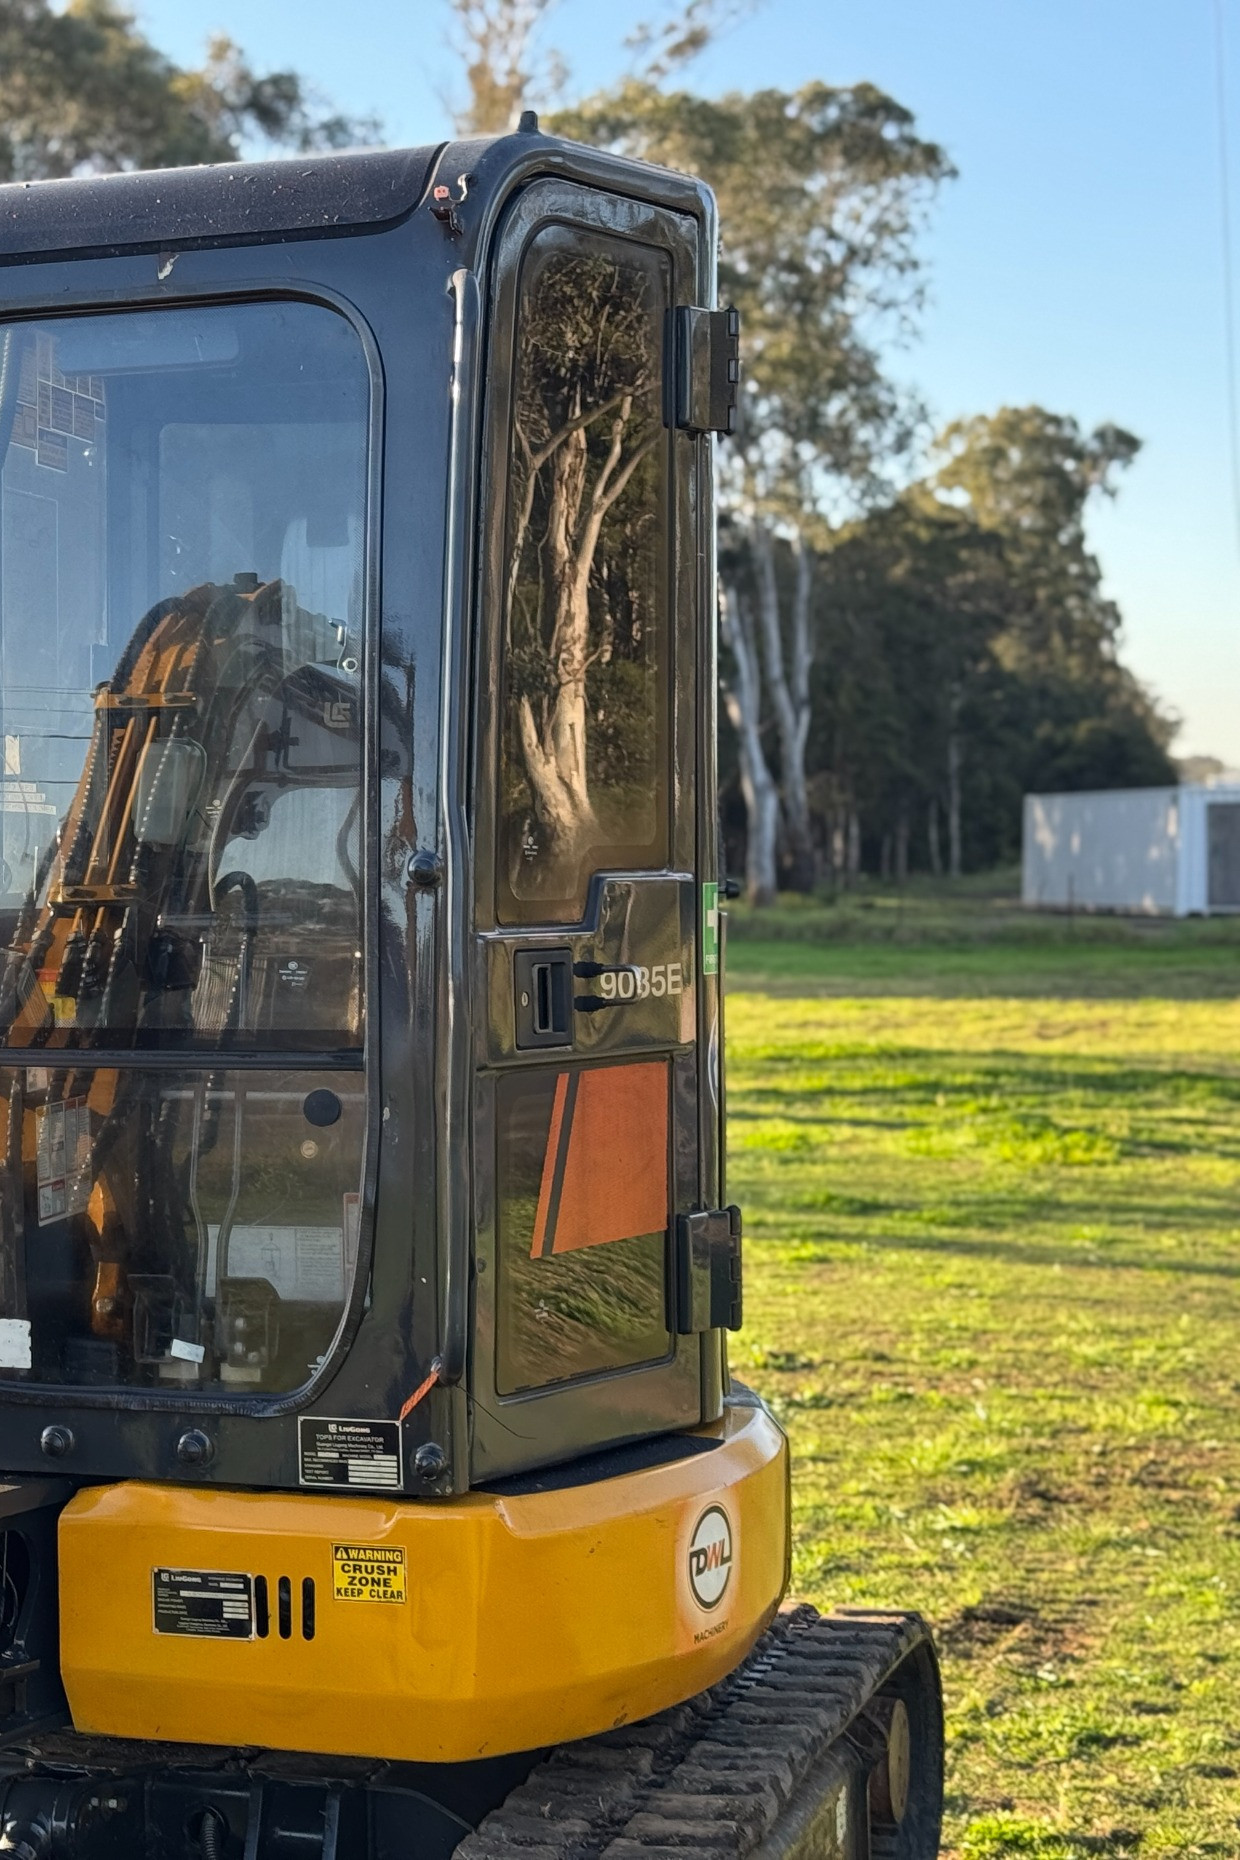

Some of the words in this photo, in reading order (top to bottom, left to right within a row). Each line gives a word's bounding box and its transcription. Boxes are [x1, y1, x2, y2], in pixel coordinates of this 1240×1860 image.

[347, 1435, 384, 1443] EXCAVATOR
[348, 1548, 402, 1562] WARNING
[690, 1538, 731, 1578] DWL
[340, 1563, 398, 1576] CRUSH
[347, 1575, 392, 1588] ZONE
[336, 1587, 363, 1598] KEEP
[369, 1589, 403, 1600] CLEAR
[693, 1620, 729, 1645] MACHINERY
